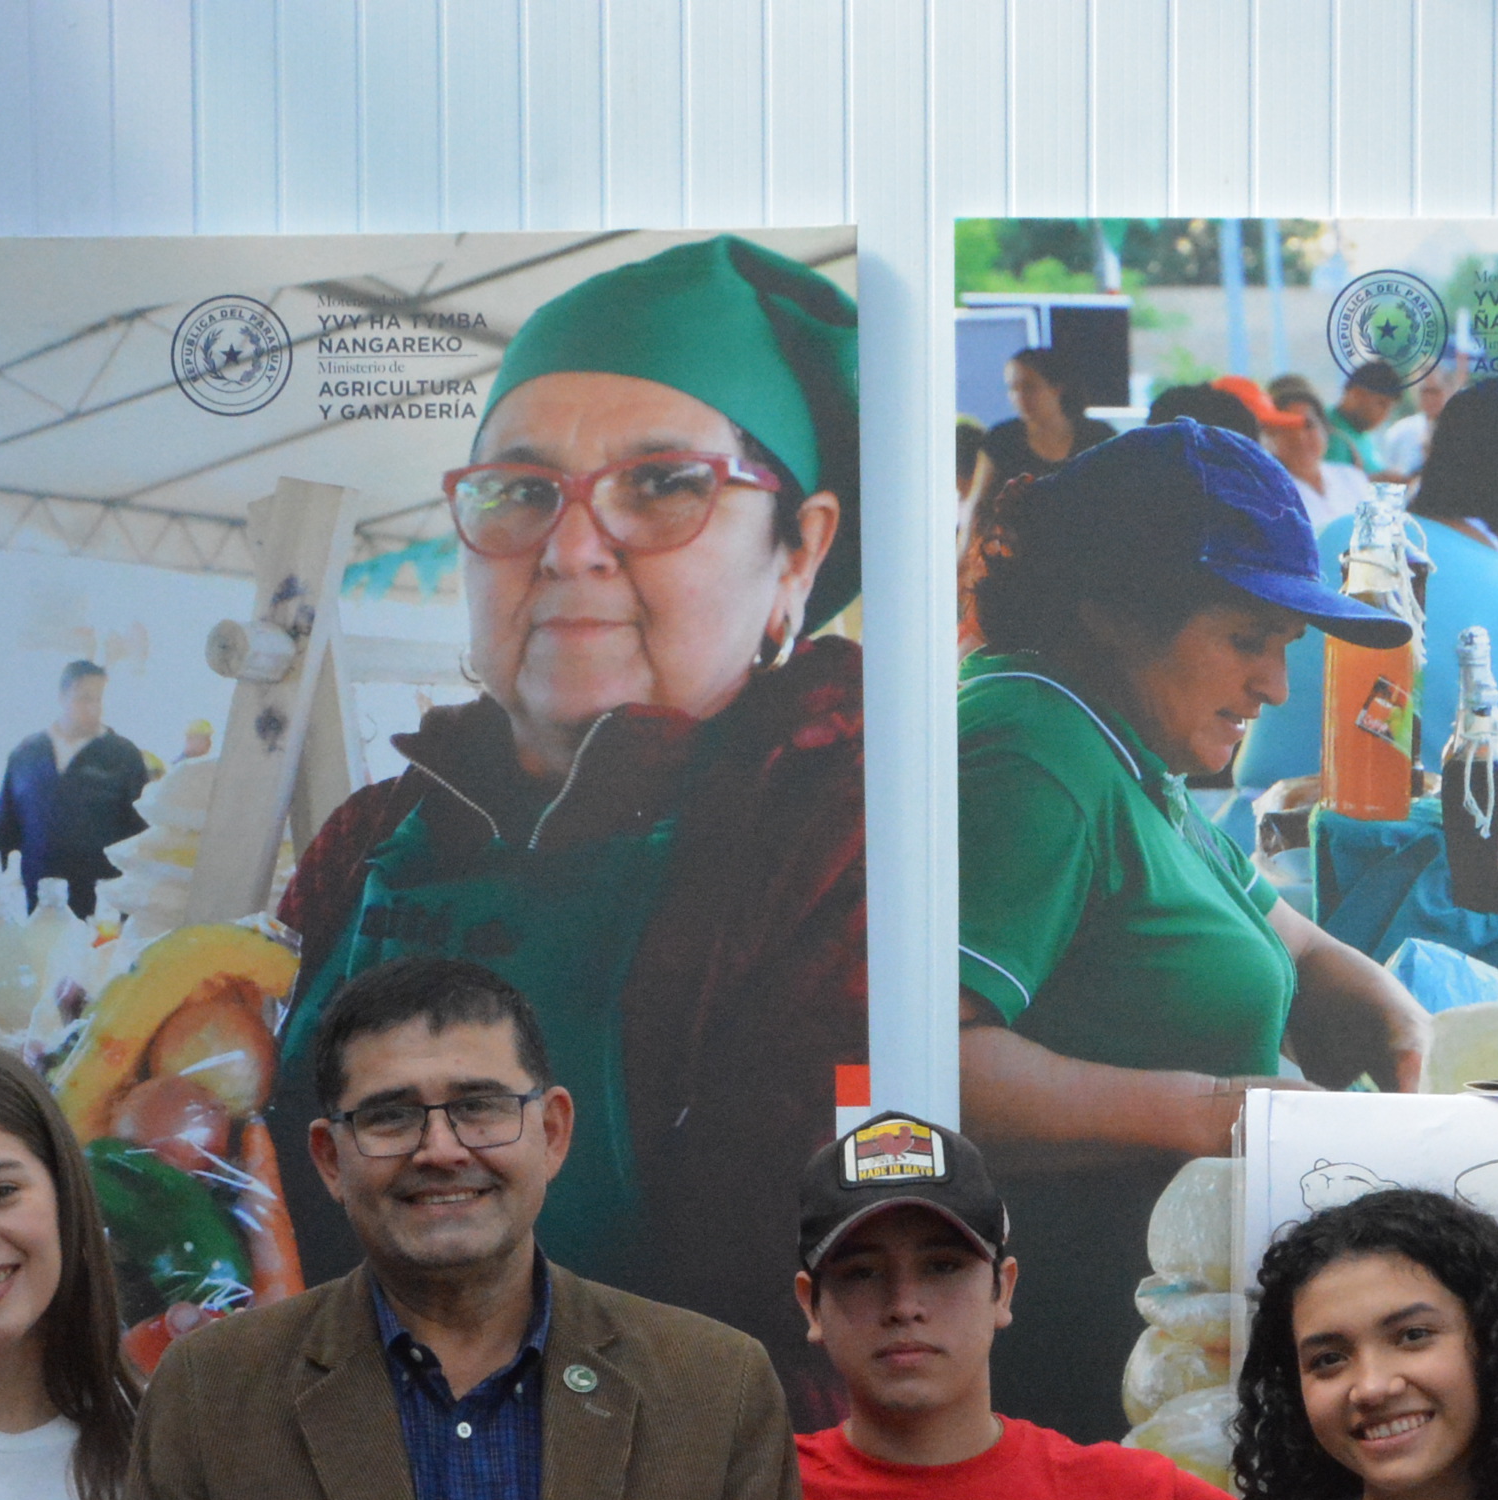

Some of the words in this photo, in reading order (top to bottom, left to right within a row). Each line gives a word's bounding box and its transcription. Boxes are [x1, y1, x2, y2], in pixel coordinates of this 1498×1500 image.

[1376, 283, 1401, 294] DEL
[219, 308, 245, 319] DEL
[318, 314, 361, 331] YVY
[370, 314, 401, 330] HA
[411, 312, 487, 329] TYMBA
[318, 333, 462, 354] ÑANGAREKO
[317, 360, 386, 374] Ministerio
[389, 360, 405, 373] de
[318, 380, 477, 397] AGRICULTURA
[319, 404, 332, 420] Y
[340, 399, 477, 420] GANADERÍA
[858, 1167, 887, 1181] MADE
[888, 1164, 901, 1175] IN
